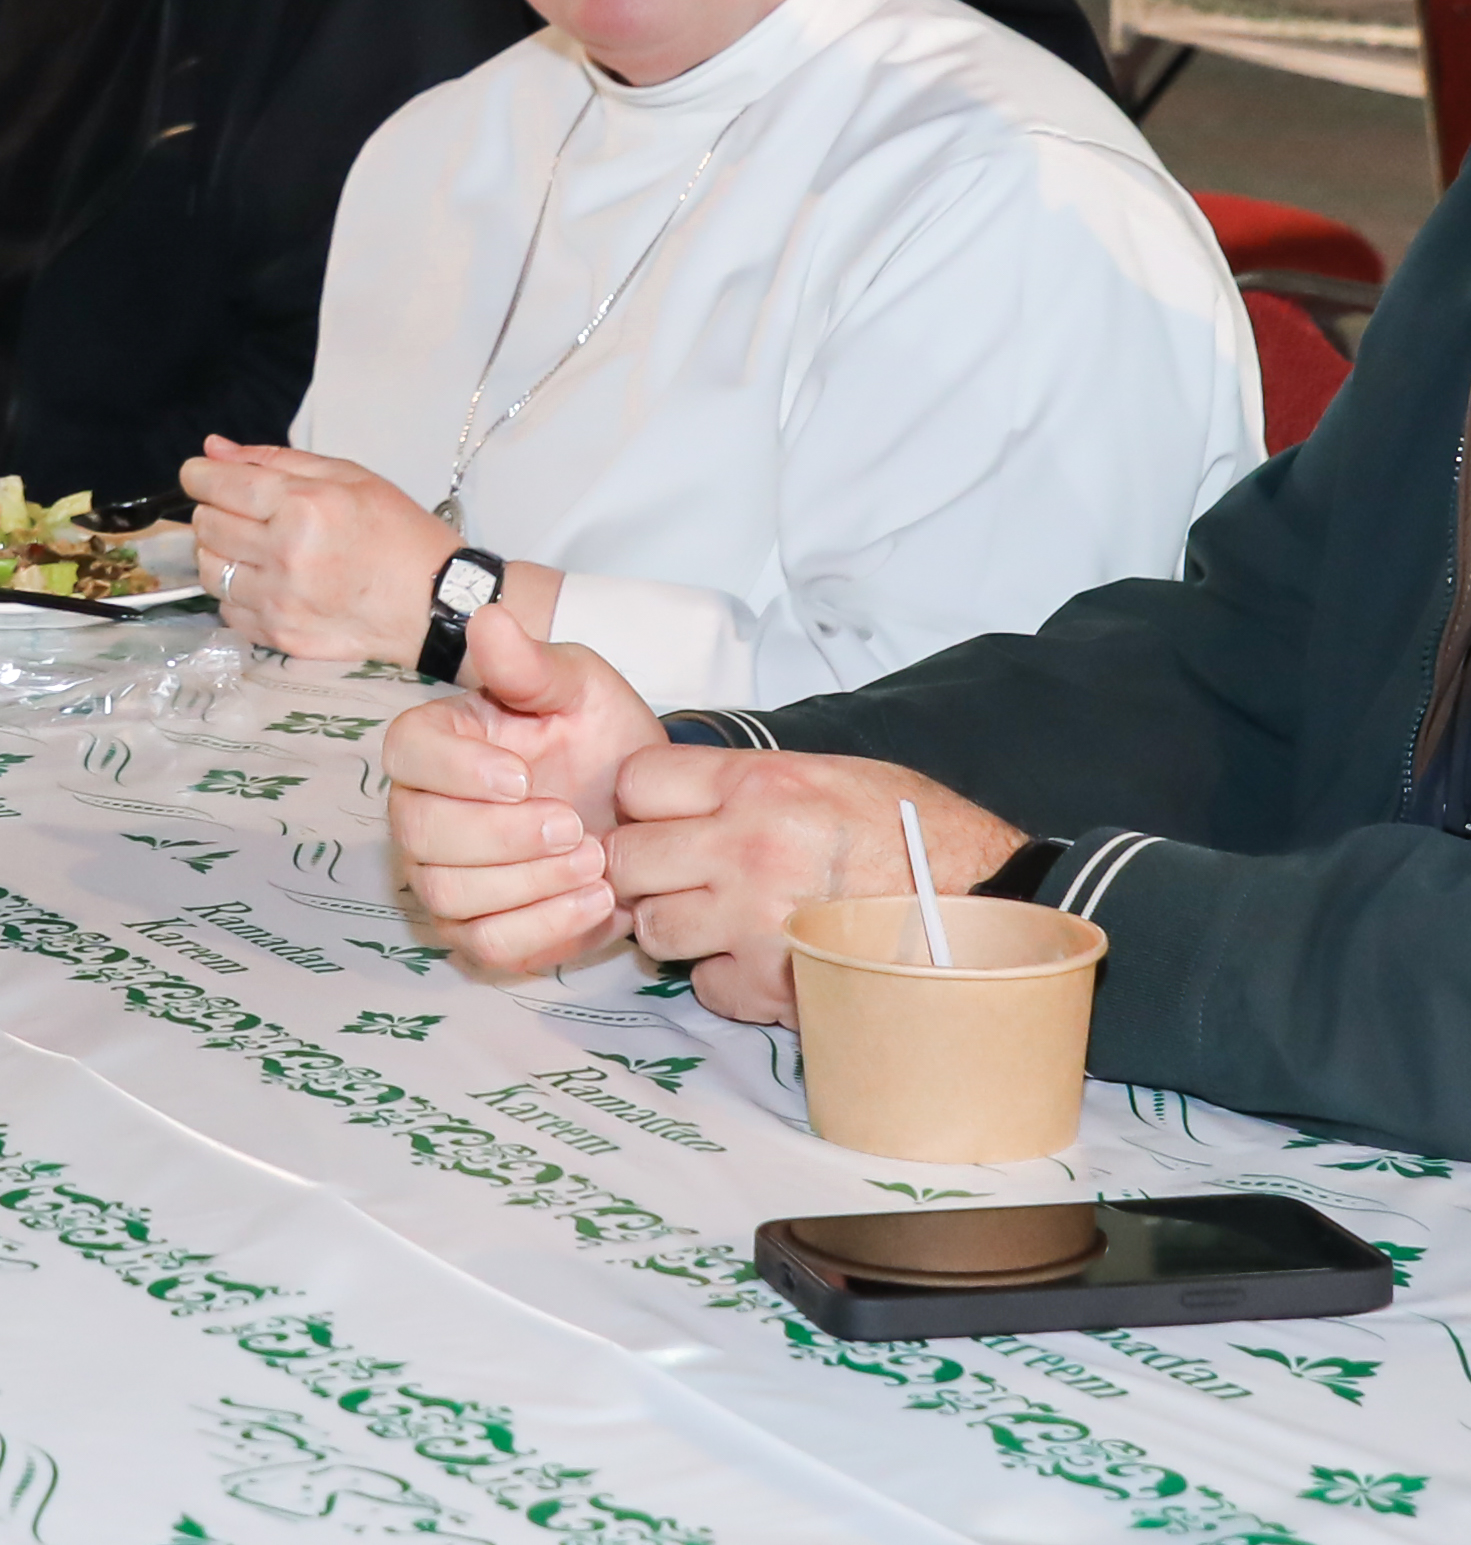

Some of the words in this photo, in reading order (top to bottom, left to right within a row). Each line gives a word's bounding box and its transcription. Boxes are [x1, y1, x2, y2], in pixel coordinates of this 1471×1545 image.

[120, 914, 250, 975] Kareem
[182, 901, 346, 975] Ramadan
[467, 1083, 621, 1156] Kareem
[529, 1065, 727, 1153] Ramadan
[970, 1334, 1129, 1398] areem
